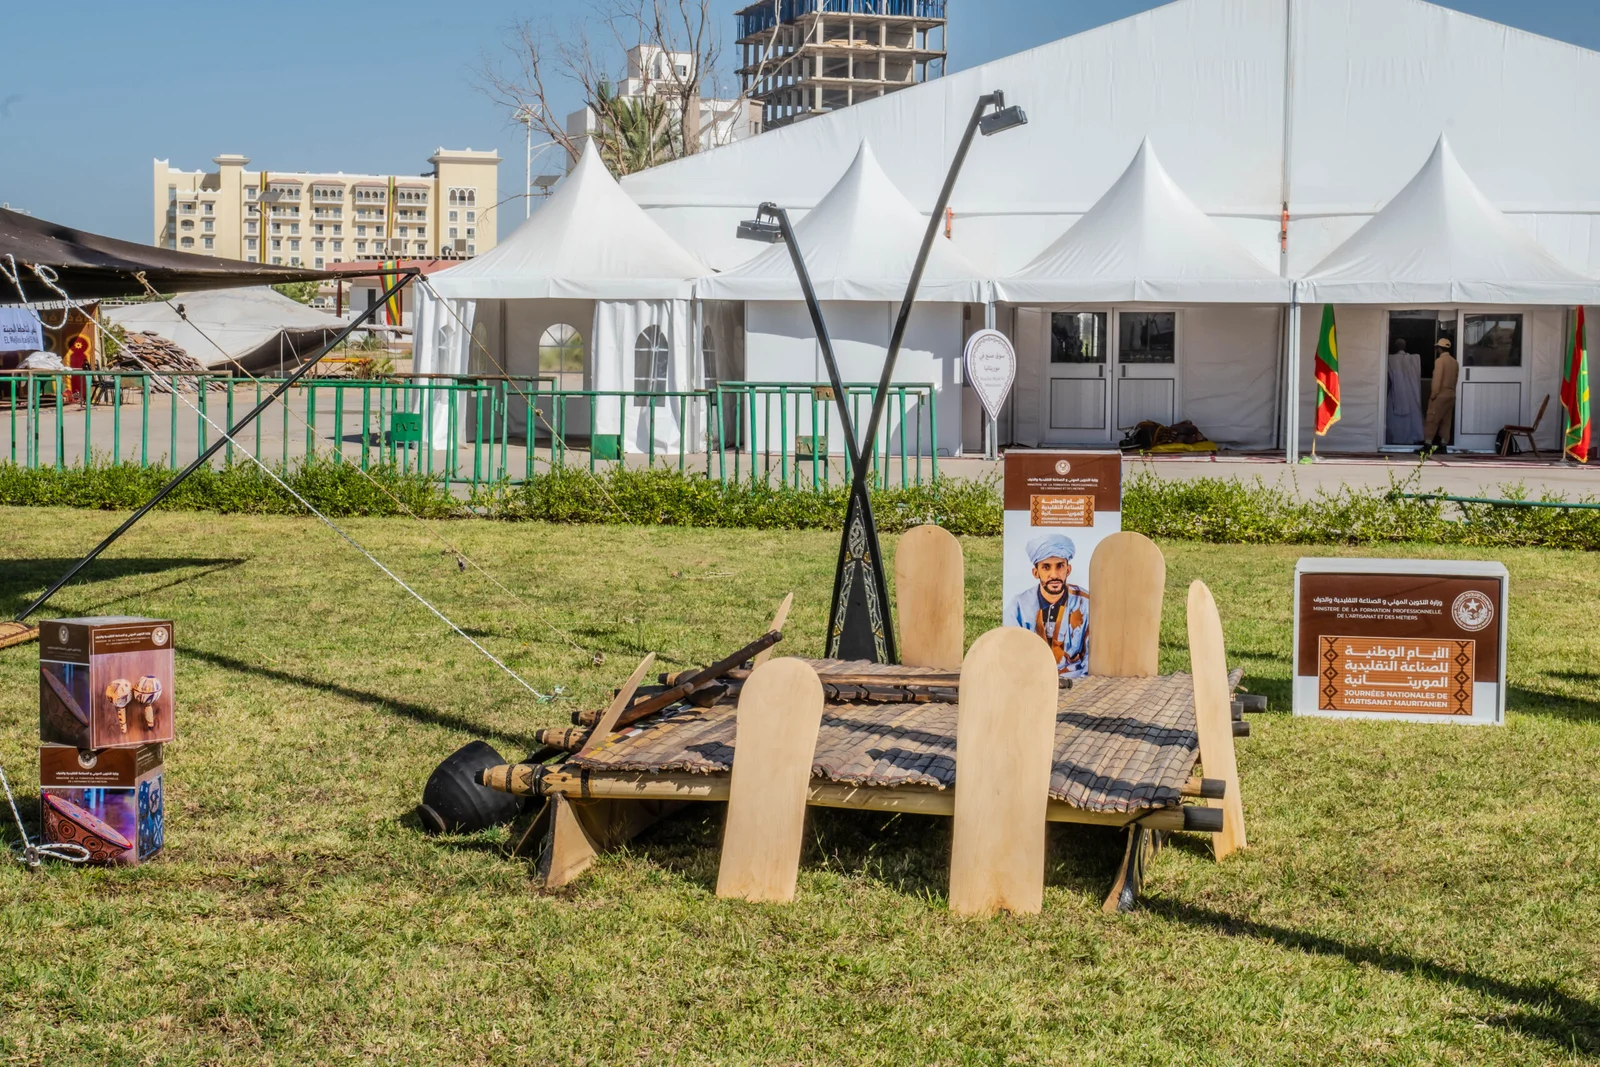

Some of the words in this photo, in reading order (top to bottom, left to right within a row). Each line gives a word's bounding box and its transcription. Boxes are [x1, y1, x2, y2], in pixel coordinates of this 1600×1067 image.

[1387, 598, 1408, 606] المهني
[1344, 645, 1405, 659] الوطنية
[1344, 659, 1397, 673] التقليدية
[1400, 661, 1448, 673] للصناعة
[1344, 674, 1448, 689] الموريتانية
[1344, 698, 1392, 706] L'ARTISANAT
[1394, 700, 1448, 708] MAURITANIEN
